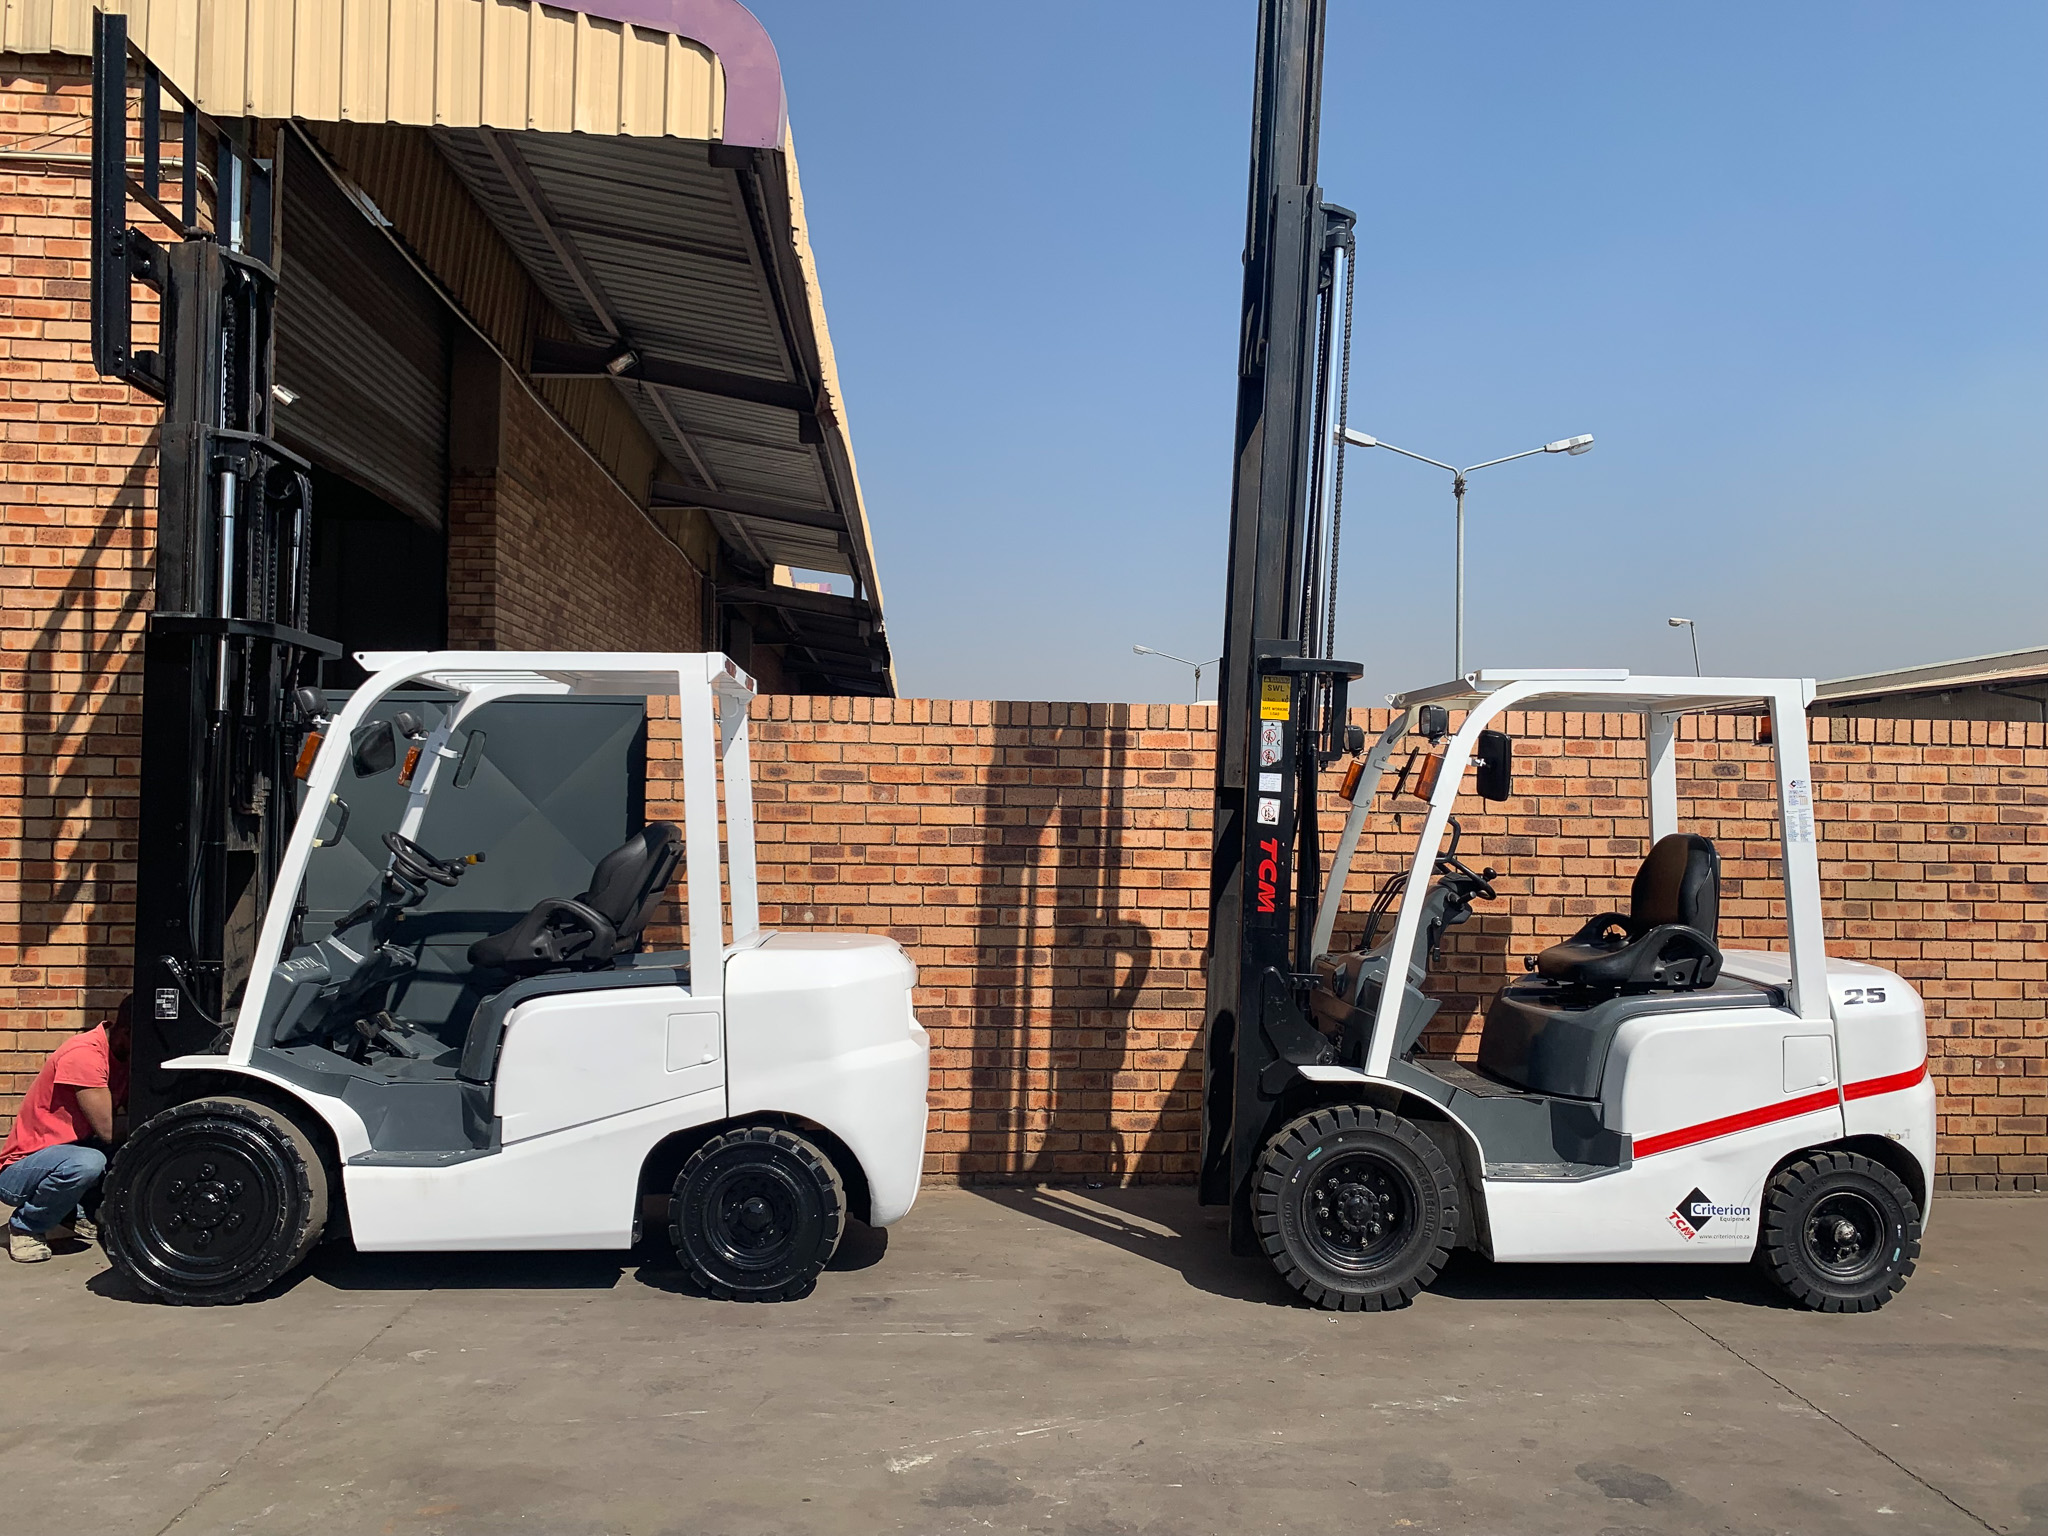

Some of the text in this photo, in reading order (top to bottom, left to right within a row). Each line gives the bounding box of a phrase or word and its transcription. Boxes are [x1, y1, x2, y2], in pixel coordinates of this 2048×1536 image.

[1267, 684, 1285, 692] SWL
[1257, 837, 1278, 913] TCM
[1843, 987, 1886, 1005] 25
[1692, 1203, 1751, 1216] Criterion
[1669, 1211, 1696, 1240] TCM
